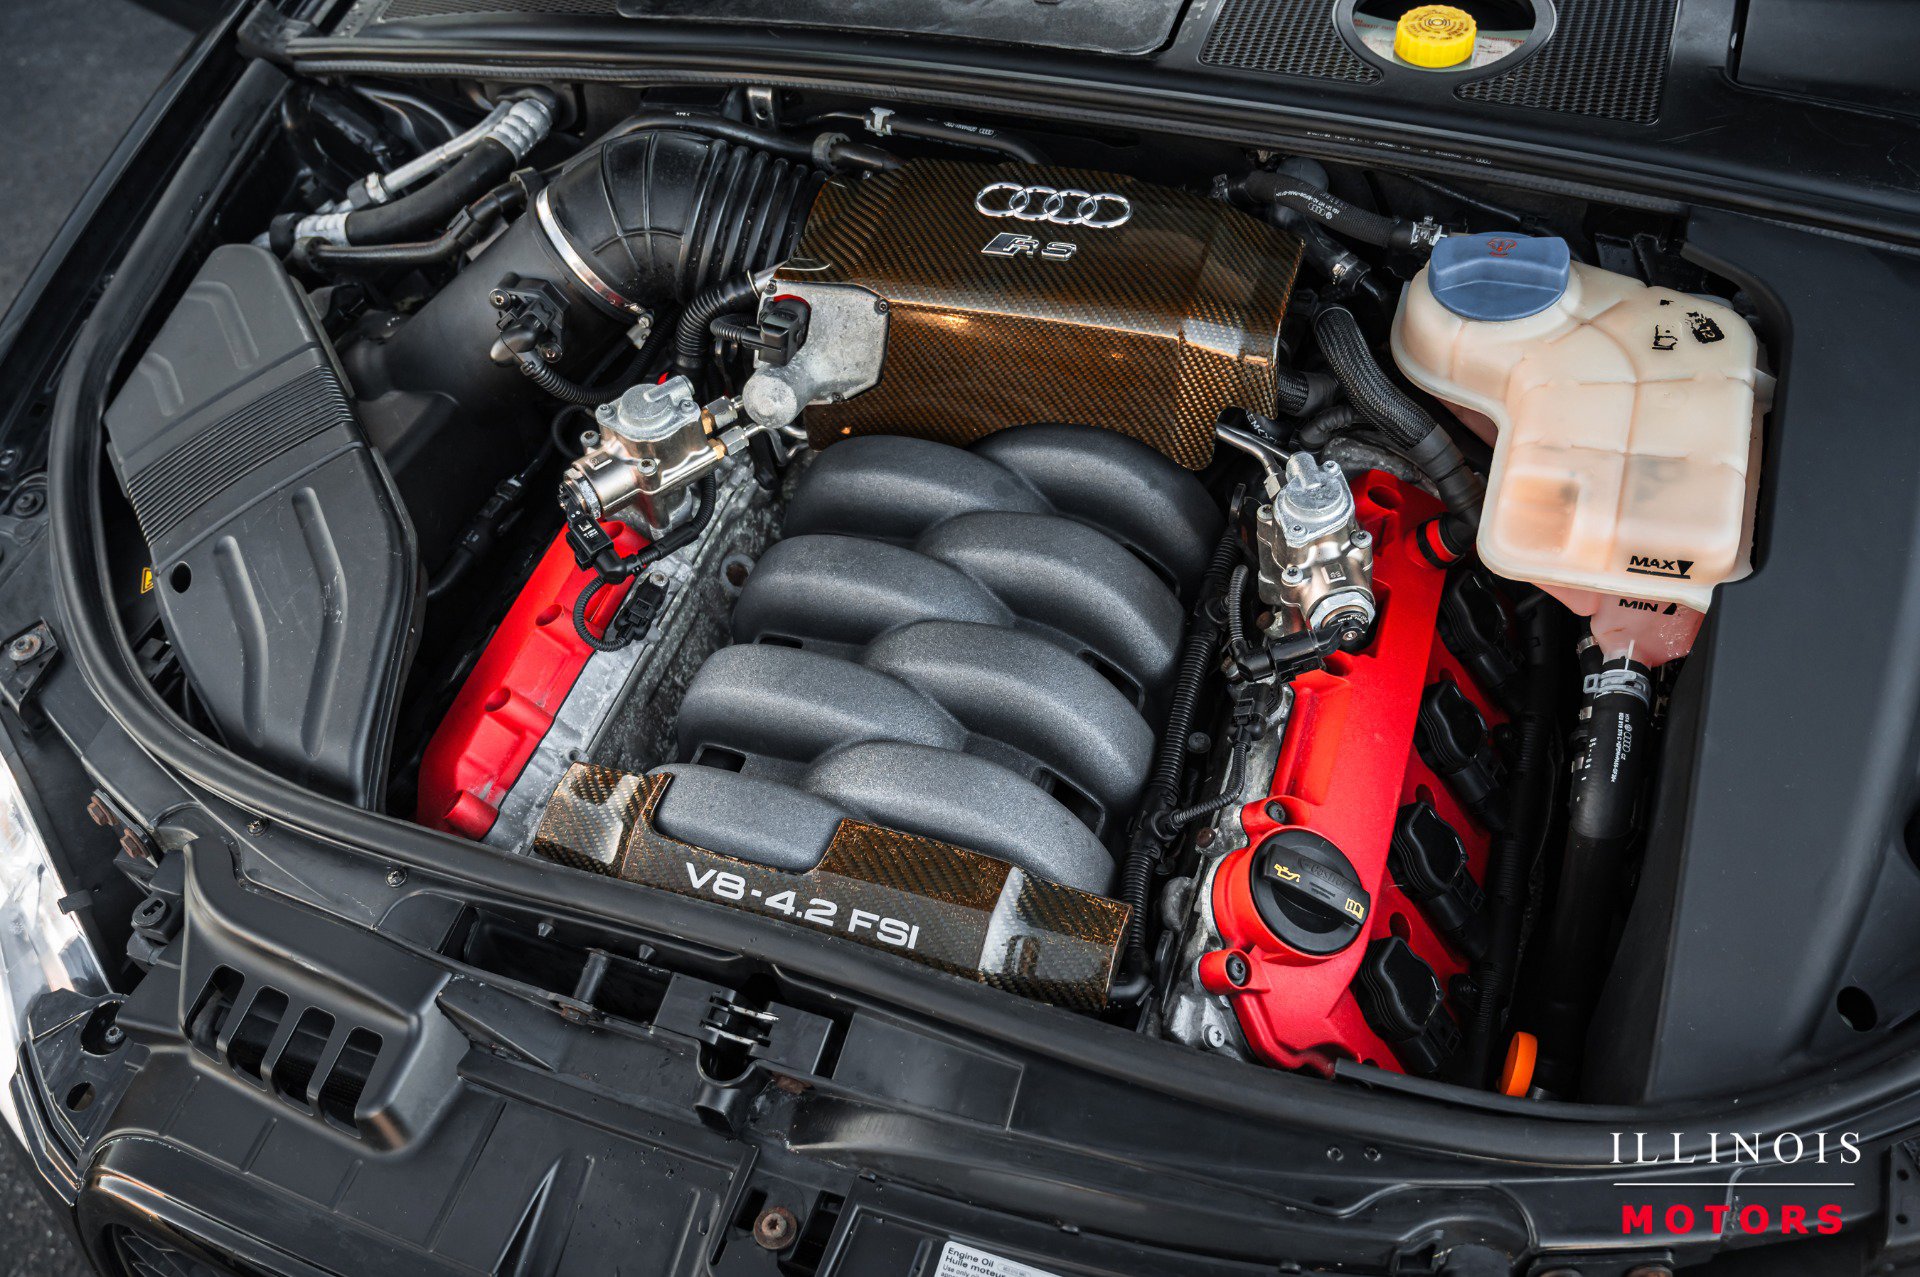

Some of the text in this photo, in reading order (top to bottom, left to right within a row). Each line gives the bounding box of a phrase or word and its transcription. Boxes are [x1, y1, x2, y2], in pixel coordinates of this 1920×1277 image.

[981, 232, 1077, 261] RS
[1630, 555, 1676, 571] MAX
[1618, 598, 1659, 612] MIN
[848, 908, 920, 949] FSI
[945, 1255, 968, 1268] Huile
[948, 1247, 995, 1268] Engine Oil
